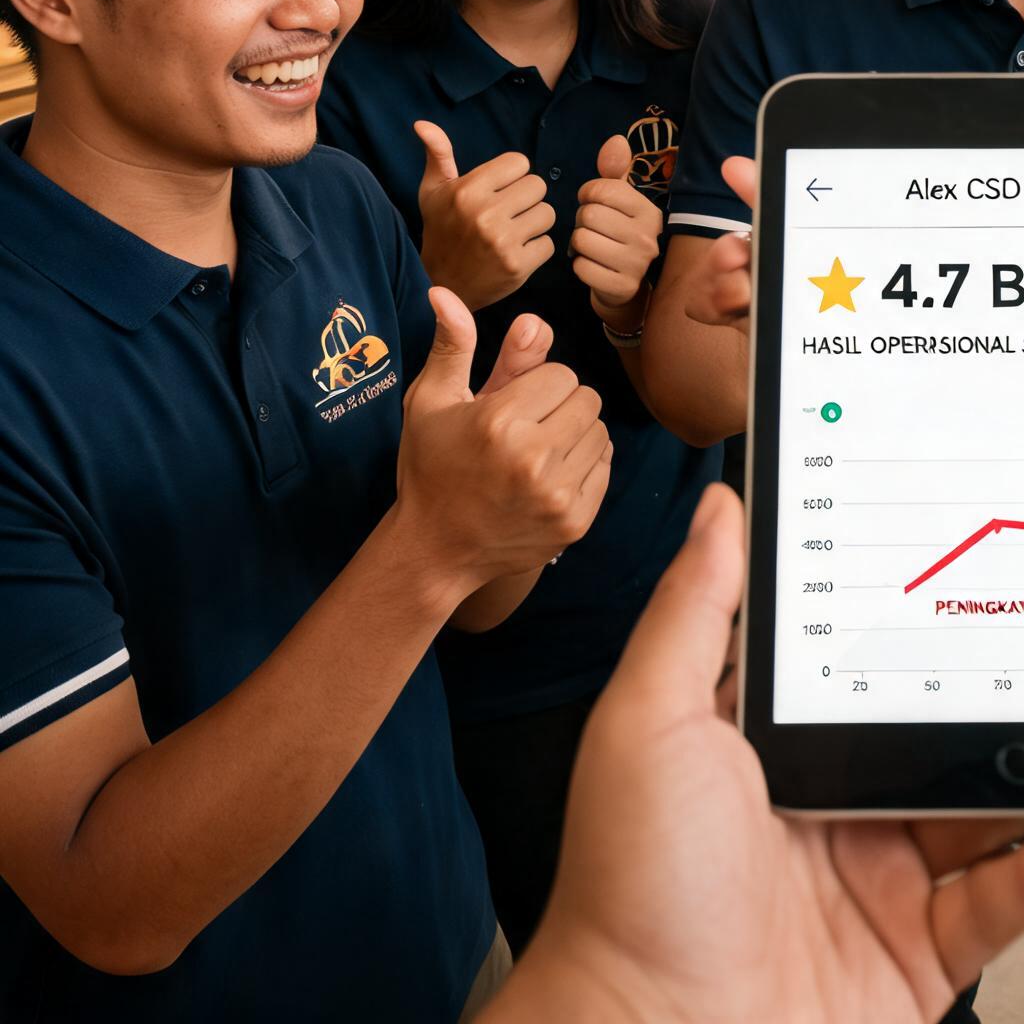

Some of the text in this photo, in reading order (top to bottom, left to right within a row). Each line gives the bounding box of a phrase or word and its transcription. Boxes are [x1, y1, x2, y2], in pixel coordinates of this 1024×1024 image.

[905, 178, 957, 201] Alex
[966, 177, 1021, 200] CSD
[881, 263, 970, 308] 4.7
[821, 665, 831, 677] 0
